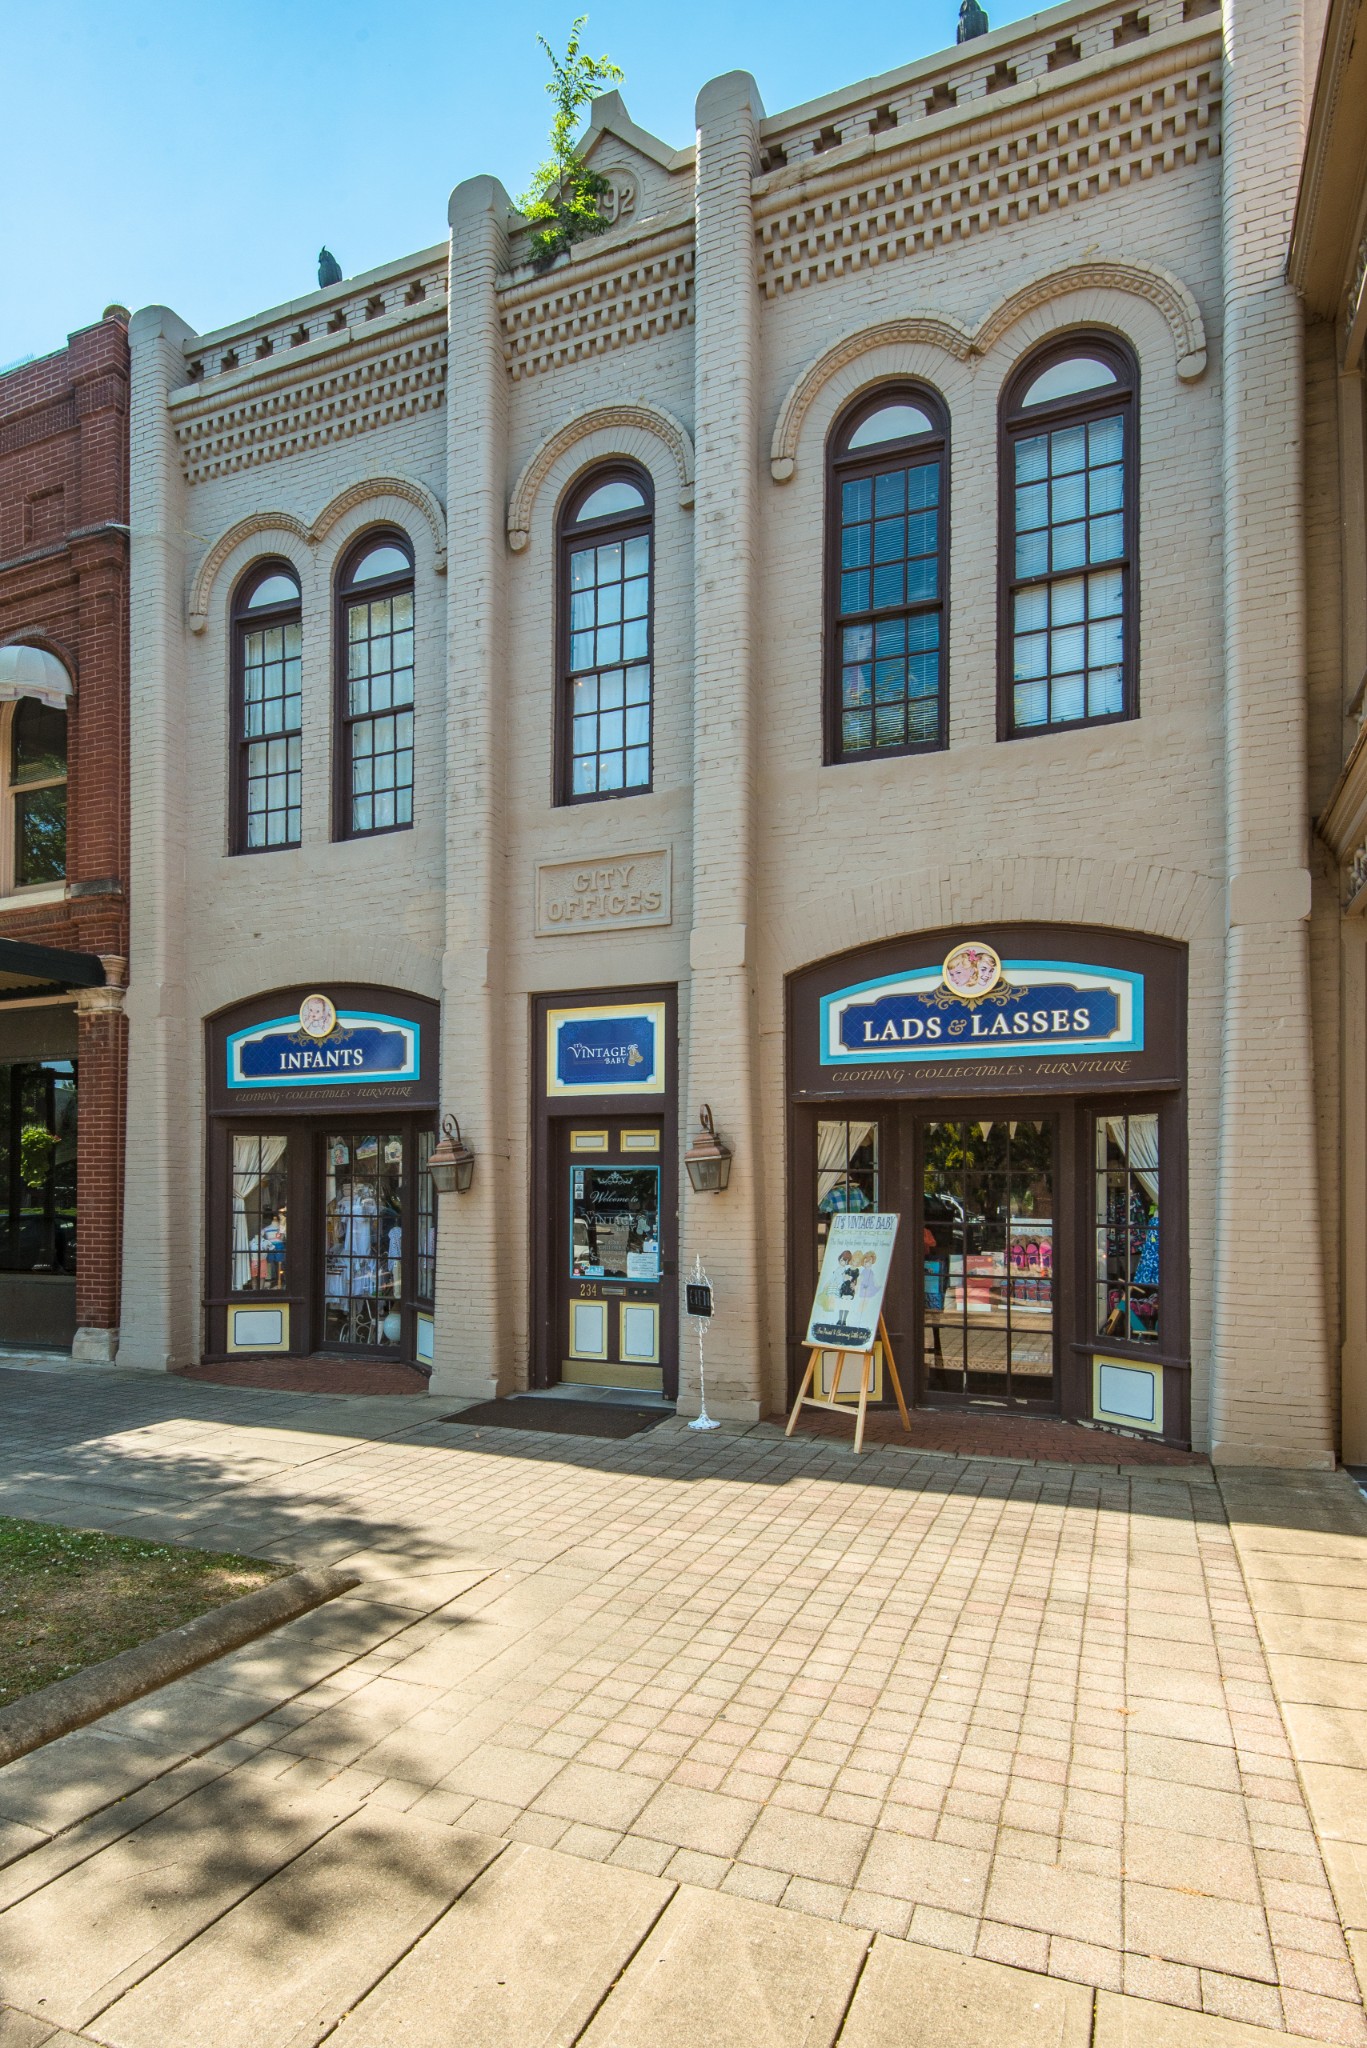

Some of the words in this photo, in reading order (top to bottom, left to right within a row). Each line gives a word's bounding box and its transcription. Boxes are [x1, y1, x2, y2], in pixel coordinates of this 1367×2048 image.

[597, 185, 634, 225] 92
[573, 866, 635, 893] CITY
[548, 890, 662, 922] OFFICES
[863, 1016, 942, 1043] LADS
[948, 1018, 967, 1036] &
[971, 1008, 1091, 1037] LASSES
[280, 1048, 363, 1069] INFANTS
[567, 1046, 627, 1059] VINTAGE
[604, 1057, 627, 1065] BABY
[832, 1068, 906, 1084] CLOTHING
[914, 1064, 1026, 1080] COLLECTIBLES
[1035, 1059, 1132, 1076] FURNITURE
[235, 1092, 281, 1104] CLOTHING
[285, 1088, 351, 1100] COLLECTIBLES
[356, 1085, 414, 1099] FURNITURE
[590, 1190, 629, 1204] Welcome
[630, 1195, 639, 1203] to
[581, 1213, 635, 1226] VINTAGE
[847, 1215, 875, 1229] VINTAGE
[876, 1215, 895, 1230] BABY
[580, 1284, 597, 1297] 234
